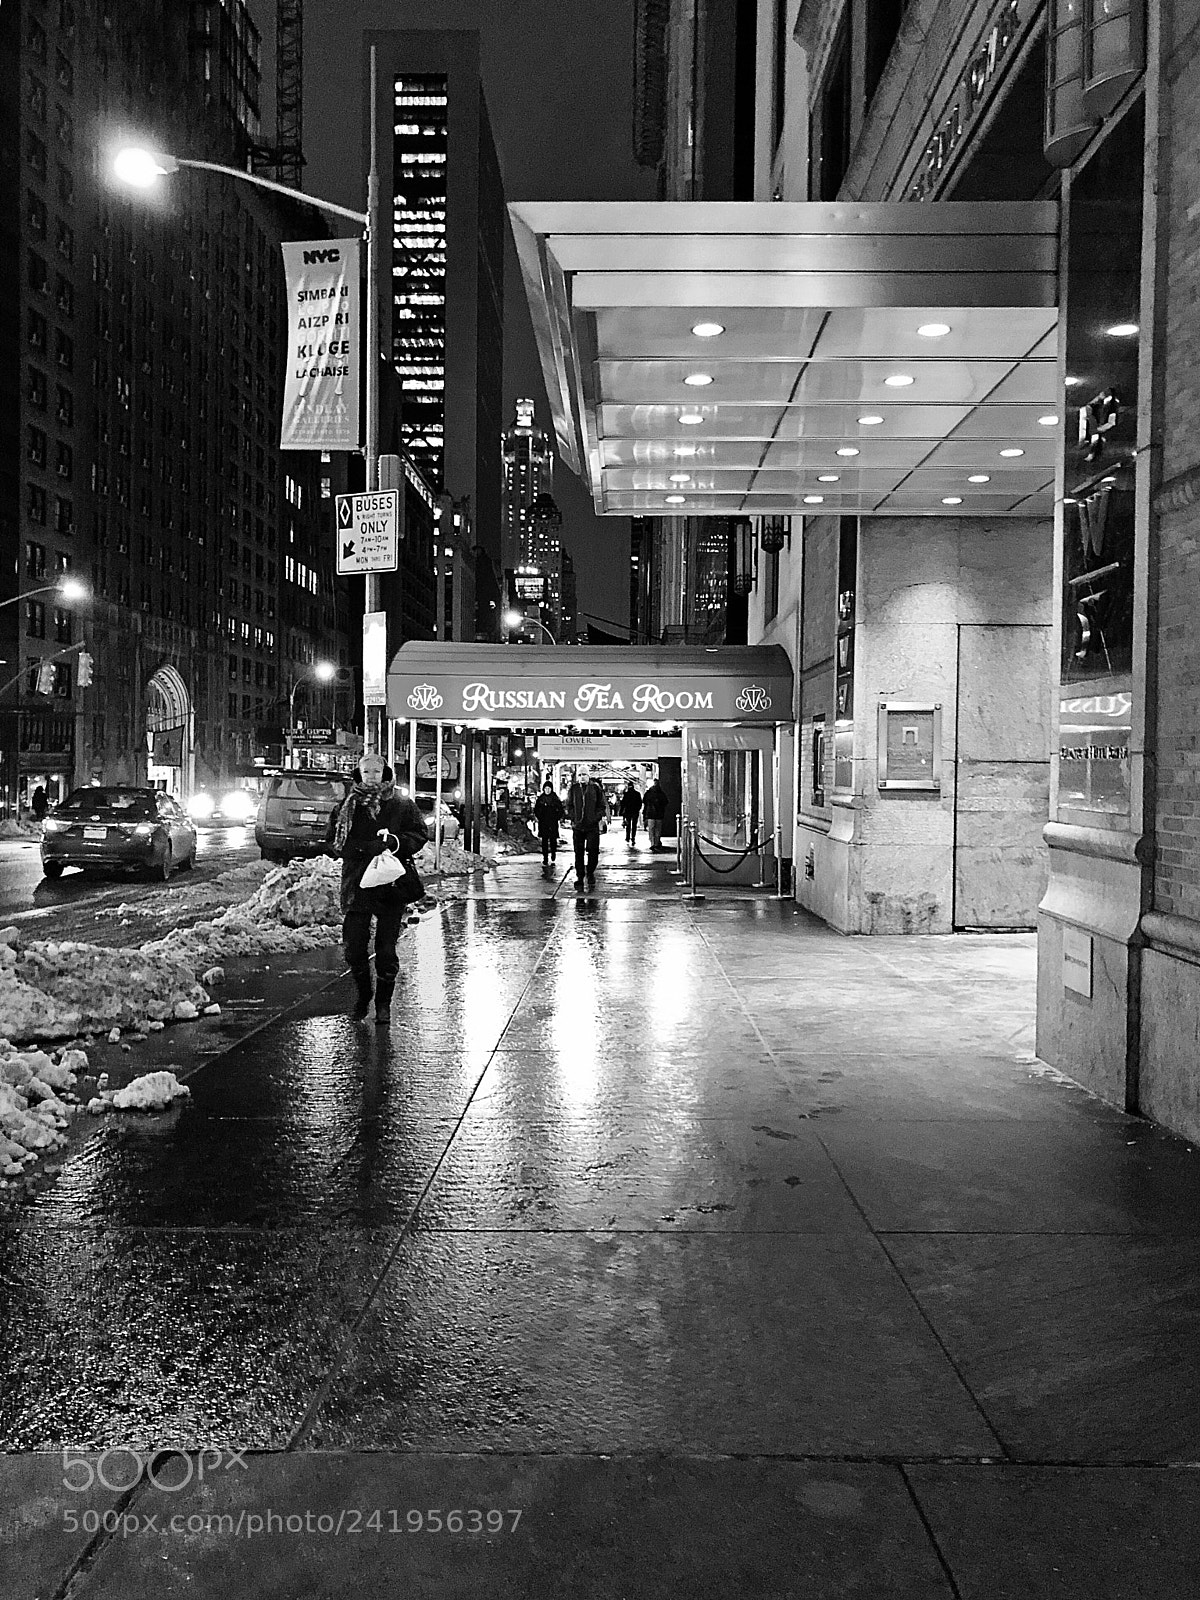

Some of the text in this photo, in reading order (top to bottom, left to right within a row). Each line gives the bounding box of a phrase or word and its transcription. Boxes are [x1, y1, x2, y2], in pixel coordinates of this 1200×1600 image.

[303, 249, 340, 265] NYC
[297, 312, 349, 330] AIZPRI
[297, 340, 350, 359] KLUGE
[295, 366, 349, 379] LACHAISE
[356, 497, 392, 512] BUSES
[361, 520, 388, 534] ONLY
[383, 554, 392, 562] FRI
[462, 682, 567, 712] RUSSIAN
[574, 683, 625, 713] TEA
[632, 684, 714, 713] ROOM
[561, 736, 593, 744] TOWER
